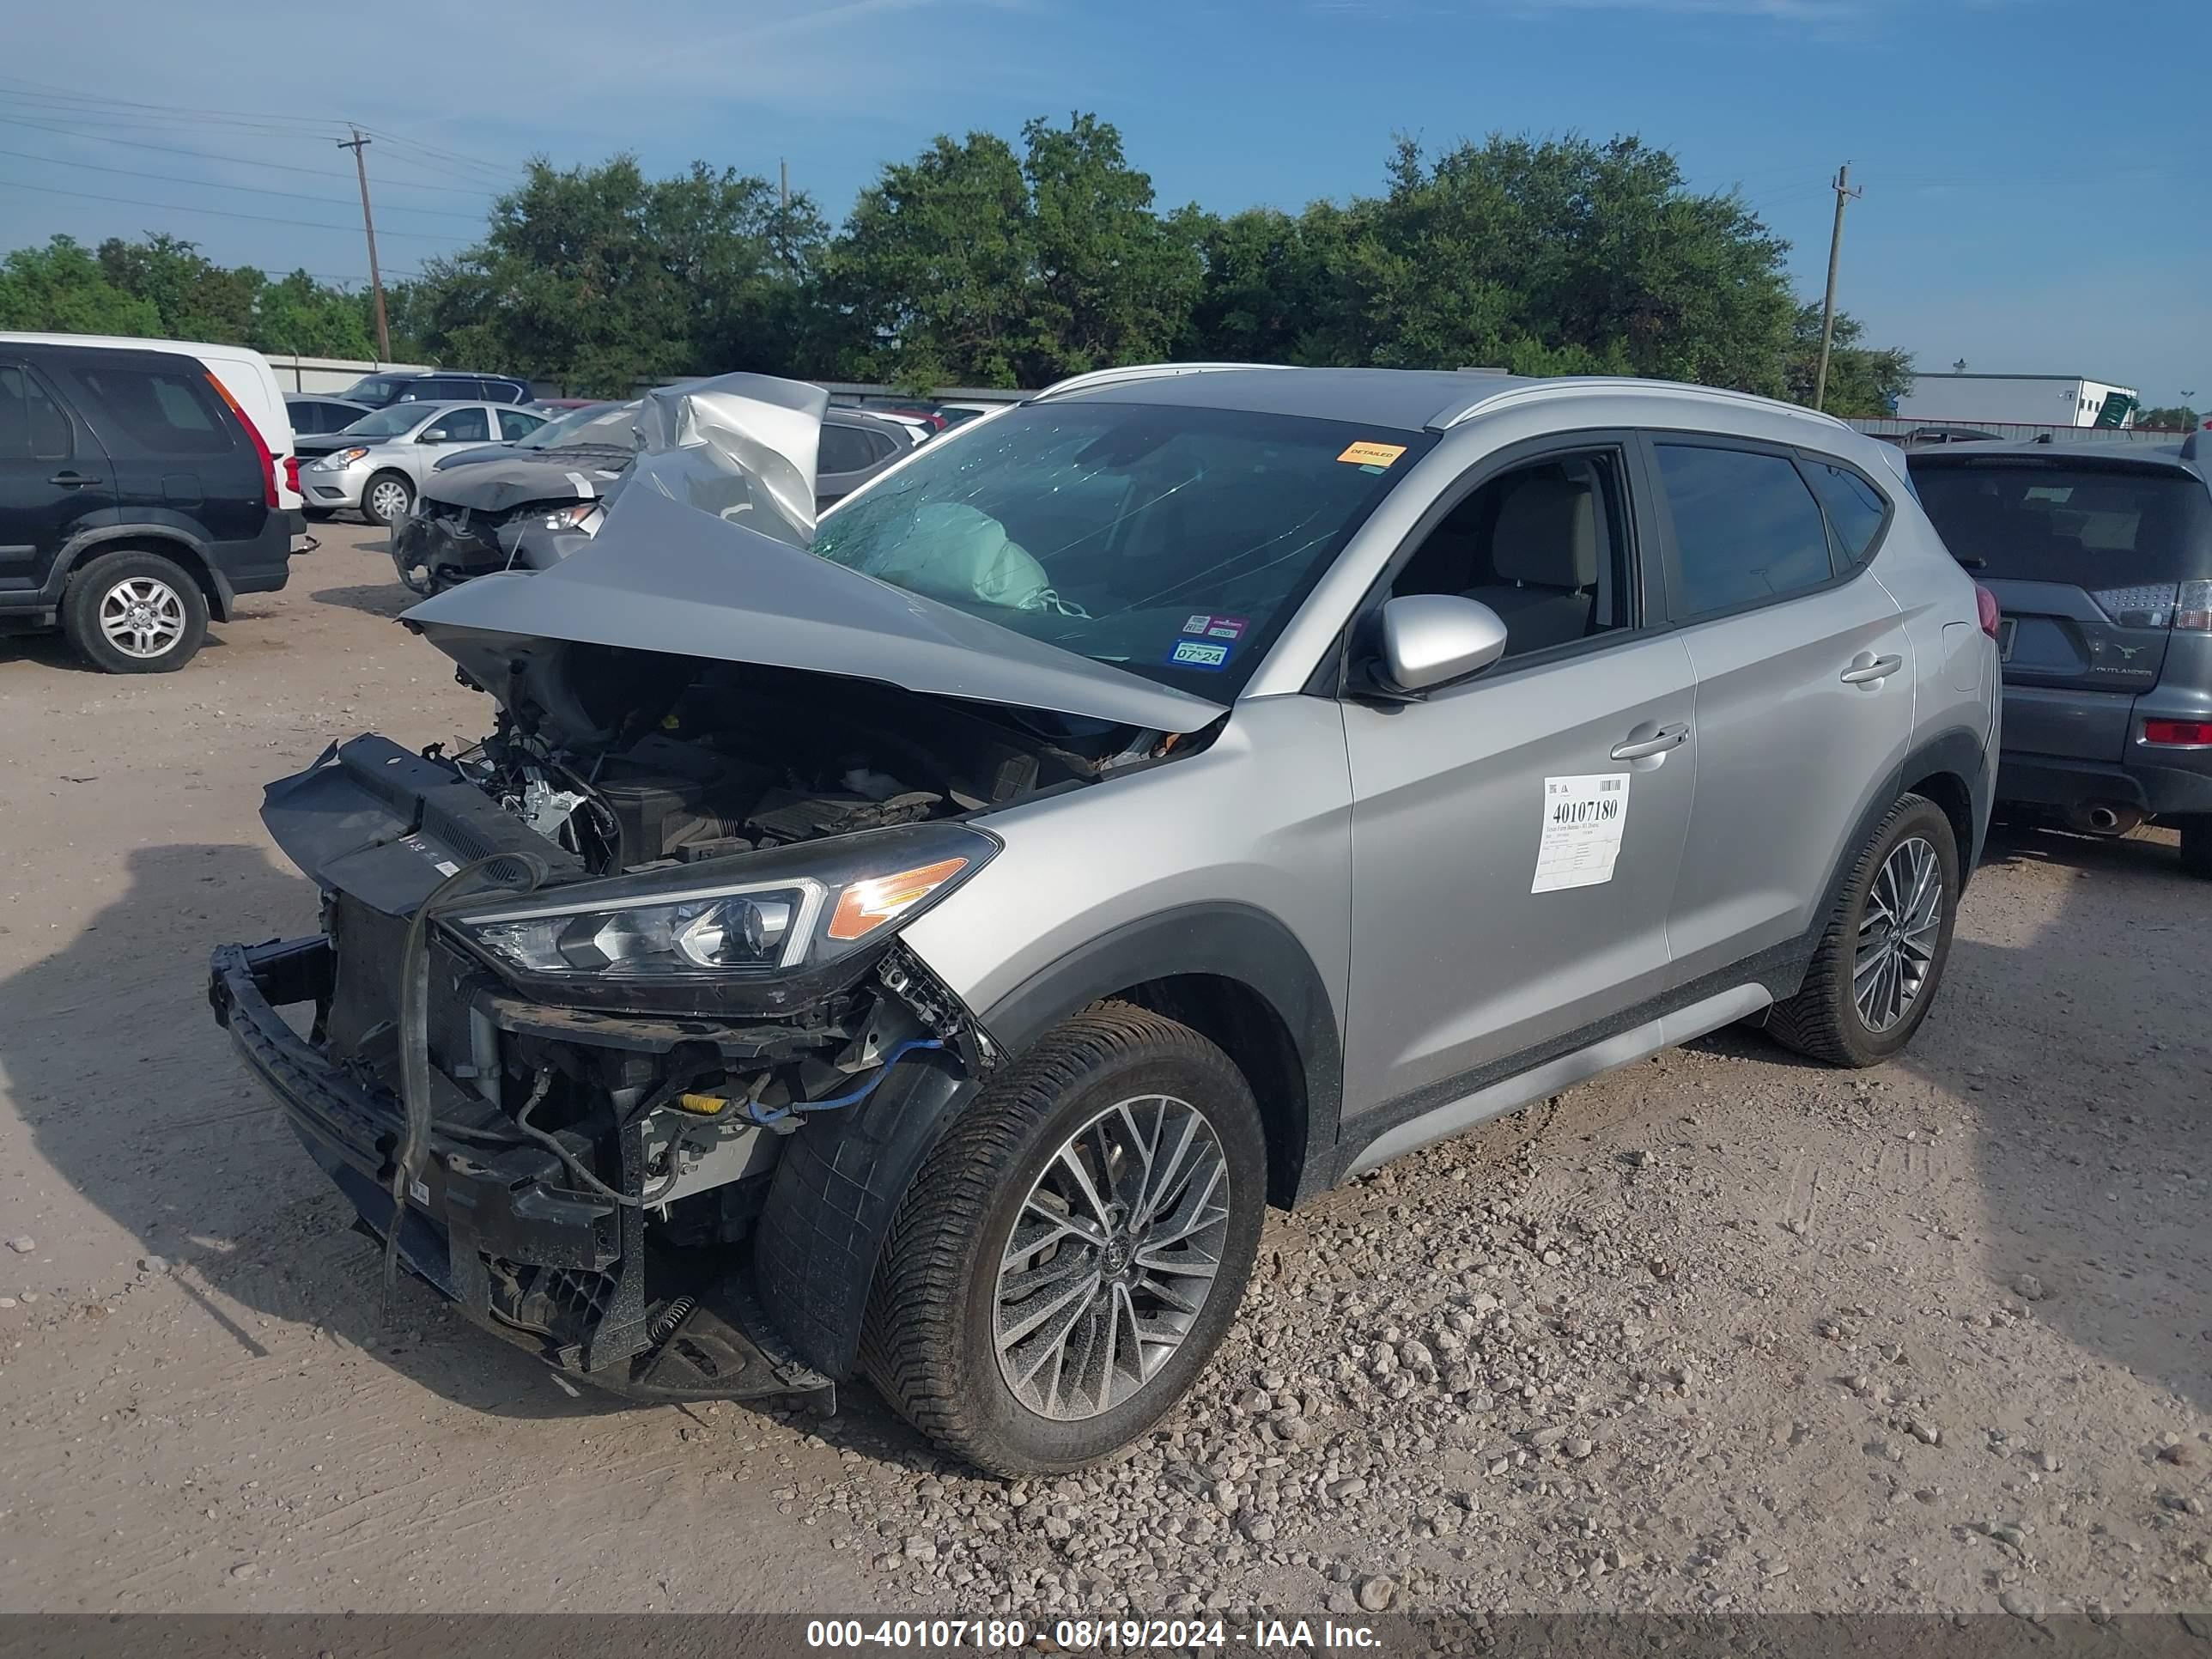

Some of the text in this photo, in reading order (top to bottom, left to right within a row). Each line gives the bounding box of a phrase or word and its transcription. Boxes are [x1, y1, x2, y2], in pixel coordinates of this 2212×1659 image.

[1177, 649, 1221, 662] 07 24
[1553, 799, 1618, 823] 40107180
